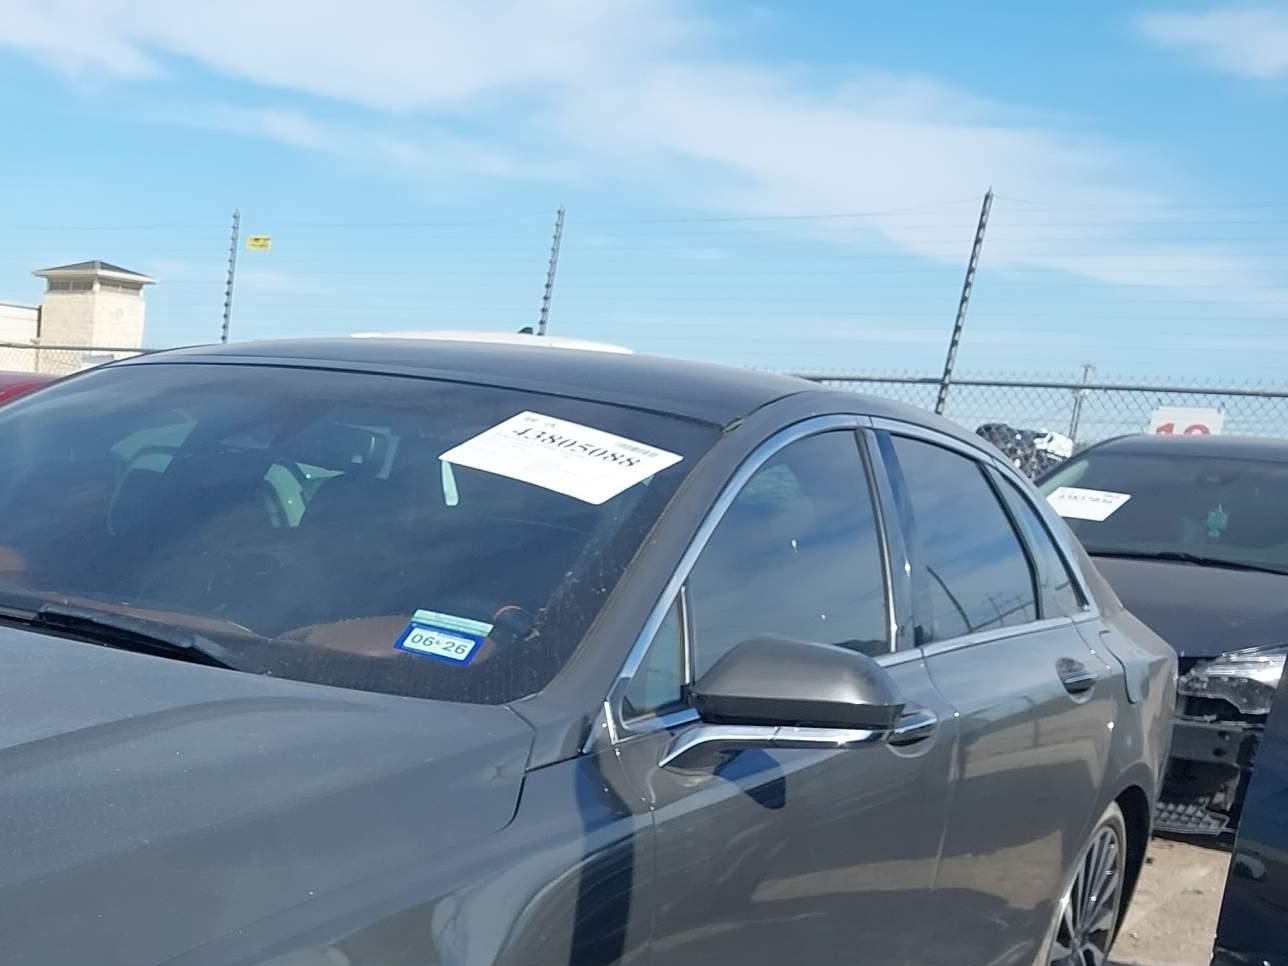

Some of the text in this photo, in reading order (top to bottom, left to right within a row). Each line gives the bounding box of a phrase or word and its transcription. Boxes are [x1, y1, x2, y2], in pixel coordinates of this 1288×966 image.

[512, 427, 641, 467] 43805088
[410, 633, 468, 655] 06 26
